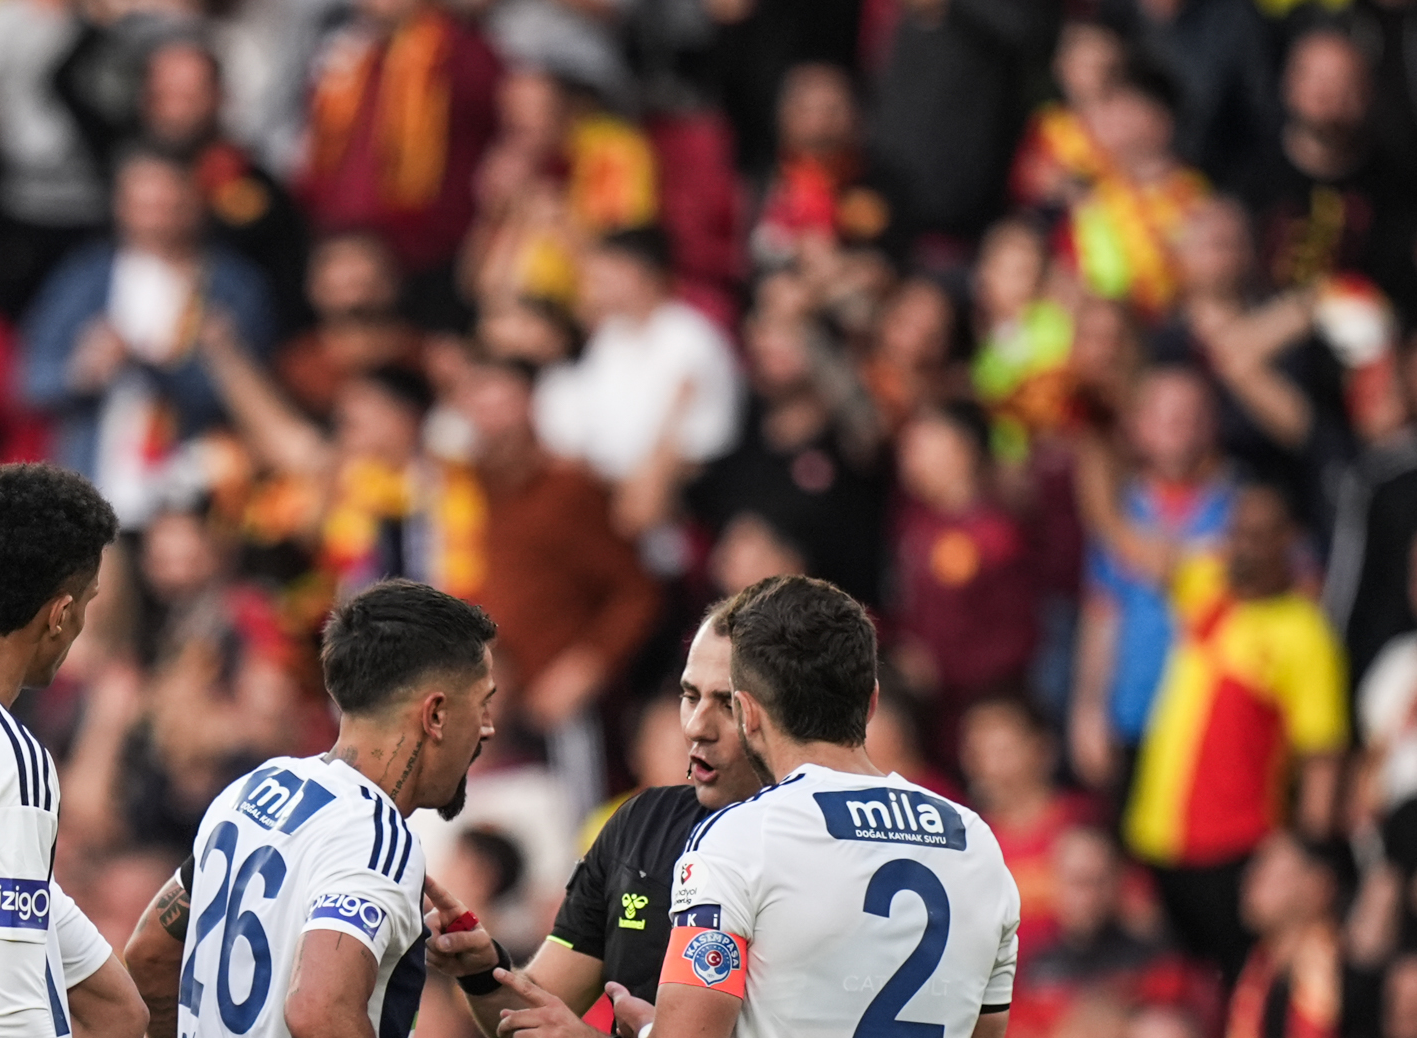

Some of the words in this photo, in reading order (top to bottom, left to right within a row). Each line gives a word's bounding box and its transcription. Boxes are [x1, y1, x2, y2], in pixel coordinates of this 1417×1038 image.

[845, 792, 944, 834] mila
[855, 828, 887, 840] DOĞAL
[888, 831, 924, 843] KAYNAK
[924, 835, 947, 845] SUYU
[179, 820, 288, 1036] 26
